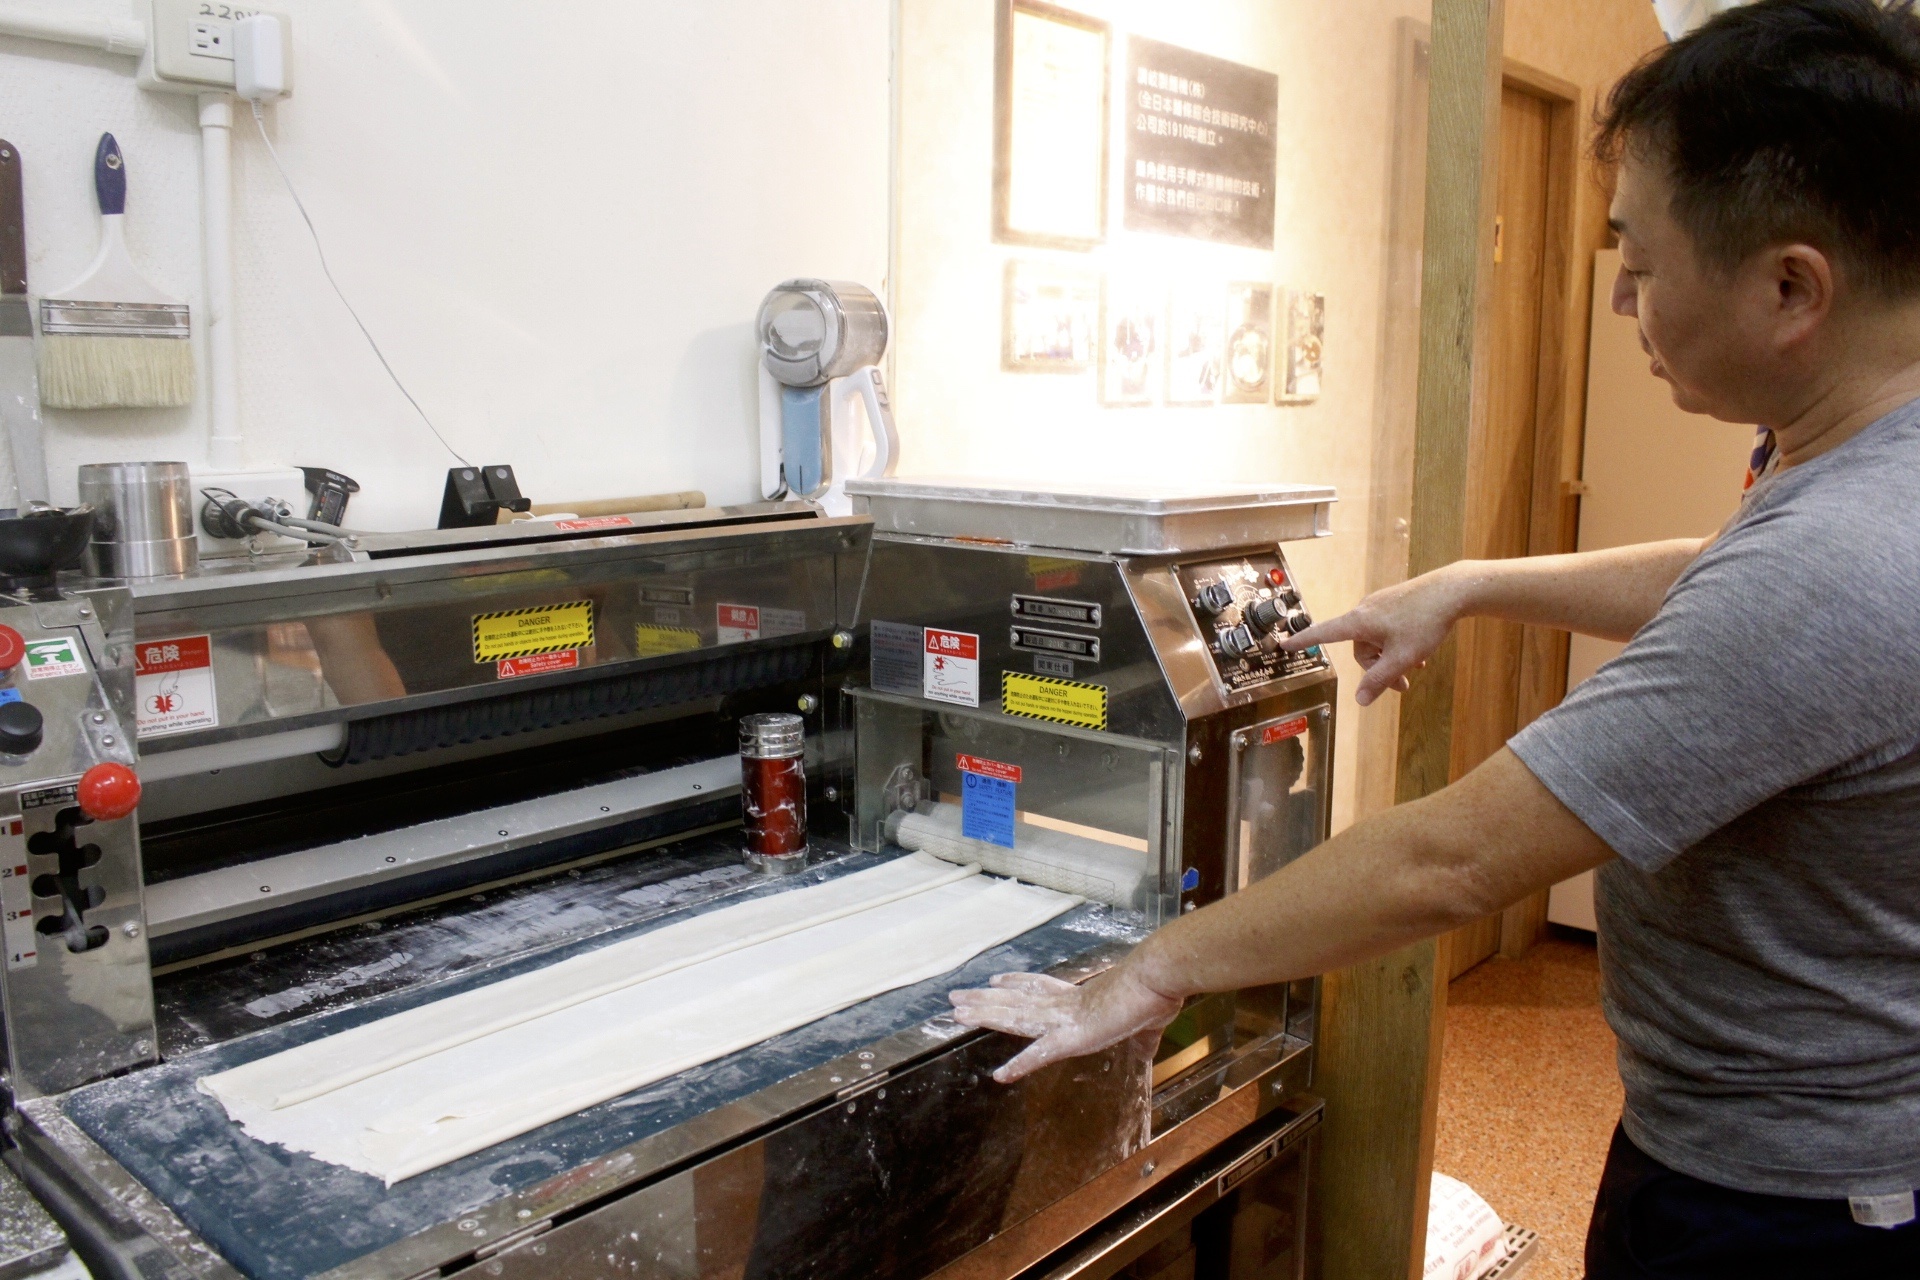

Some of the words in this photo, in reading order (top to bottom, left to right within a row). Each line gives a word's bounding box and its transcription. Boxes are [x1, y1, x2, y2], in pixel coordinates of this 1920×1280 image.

[199, 4, 260, 20] 220
[518, 616, 551, 628] DANGER
[940, 635, 960, 650] 危険
[145, 644, 180, 664] 危険
[530, 661, 546, 669] Safety
[30, 671, 62, 679] Emergency
[1040, 686, 1068, 698] DANGER
[958, 694, 975, 702] operating
[158, 716, 168, 724] put
[176, 713, 189, 721] your
[142, 724, 167, 732] anything
[185, 717, 212, 726] operating
[1, 826, 6, 835] 1
[2, 868, 13, 879] 2
[7, 911, 17, 921] 3
[11, 952, 20, 962] 4
